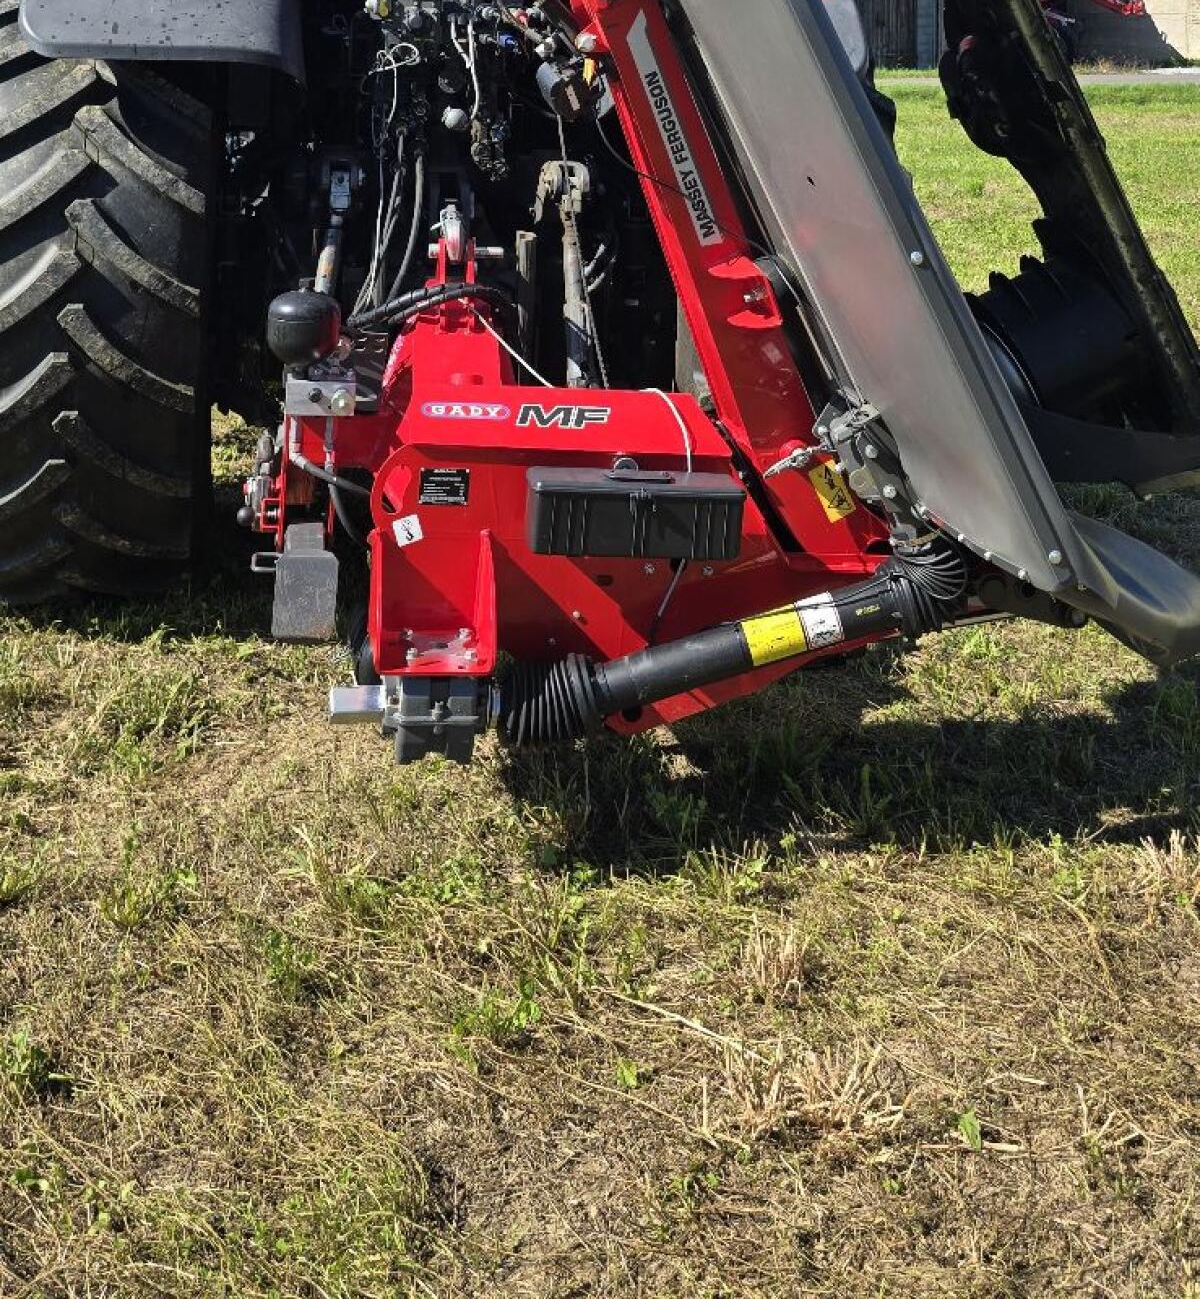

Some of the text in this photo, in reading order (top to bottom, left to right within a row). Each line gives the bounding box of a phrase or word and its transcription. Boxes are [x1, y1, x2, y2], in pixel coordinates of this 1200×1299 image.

[645, 70, 716, 239] MASSEY FERGUSON
[431, 404, 500, 417] GADY
[516, 403, 611, 429] MF
